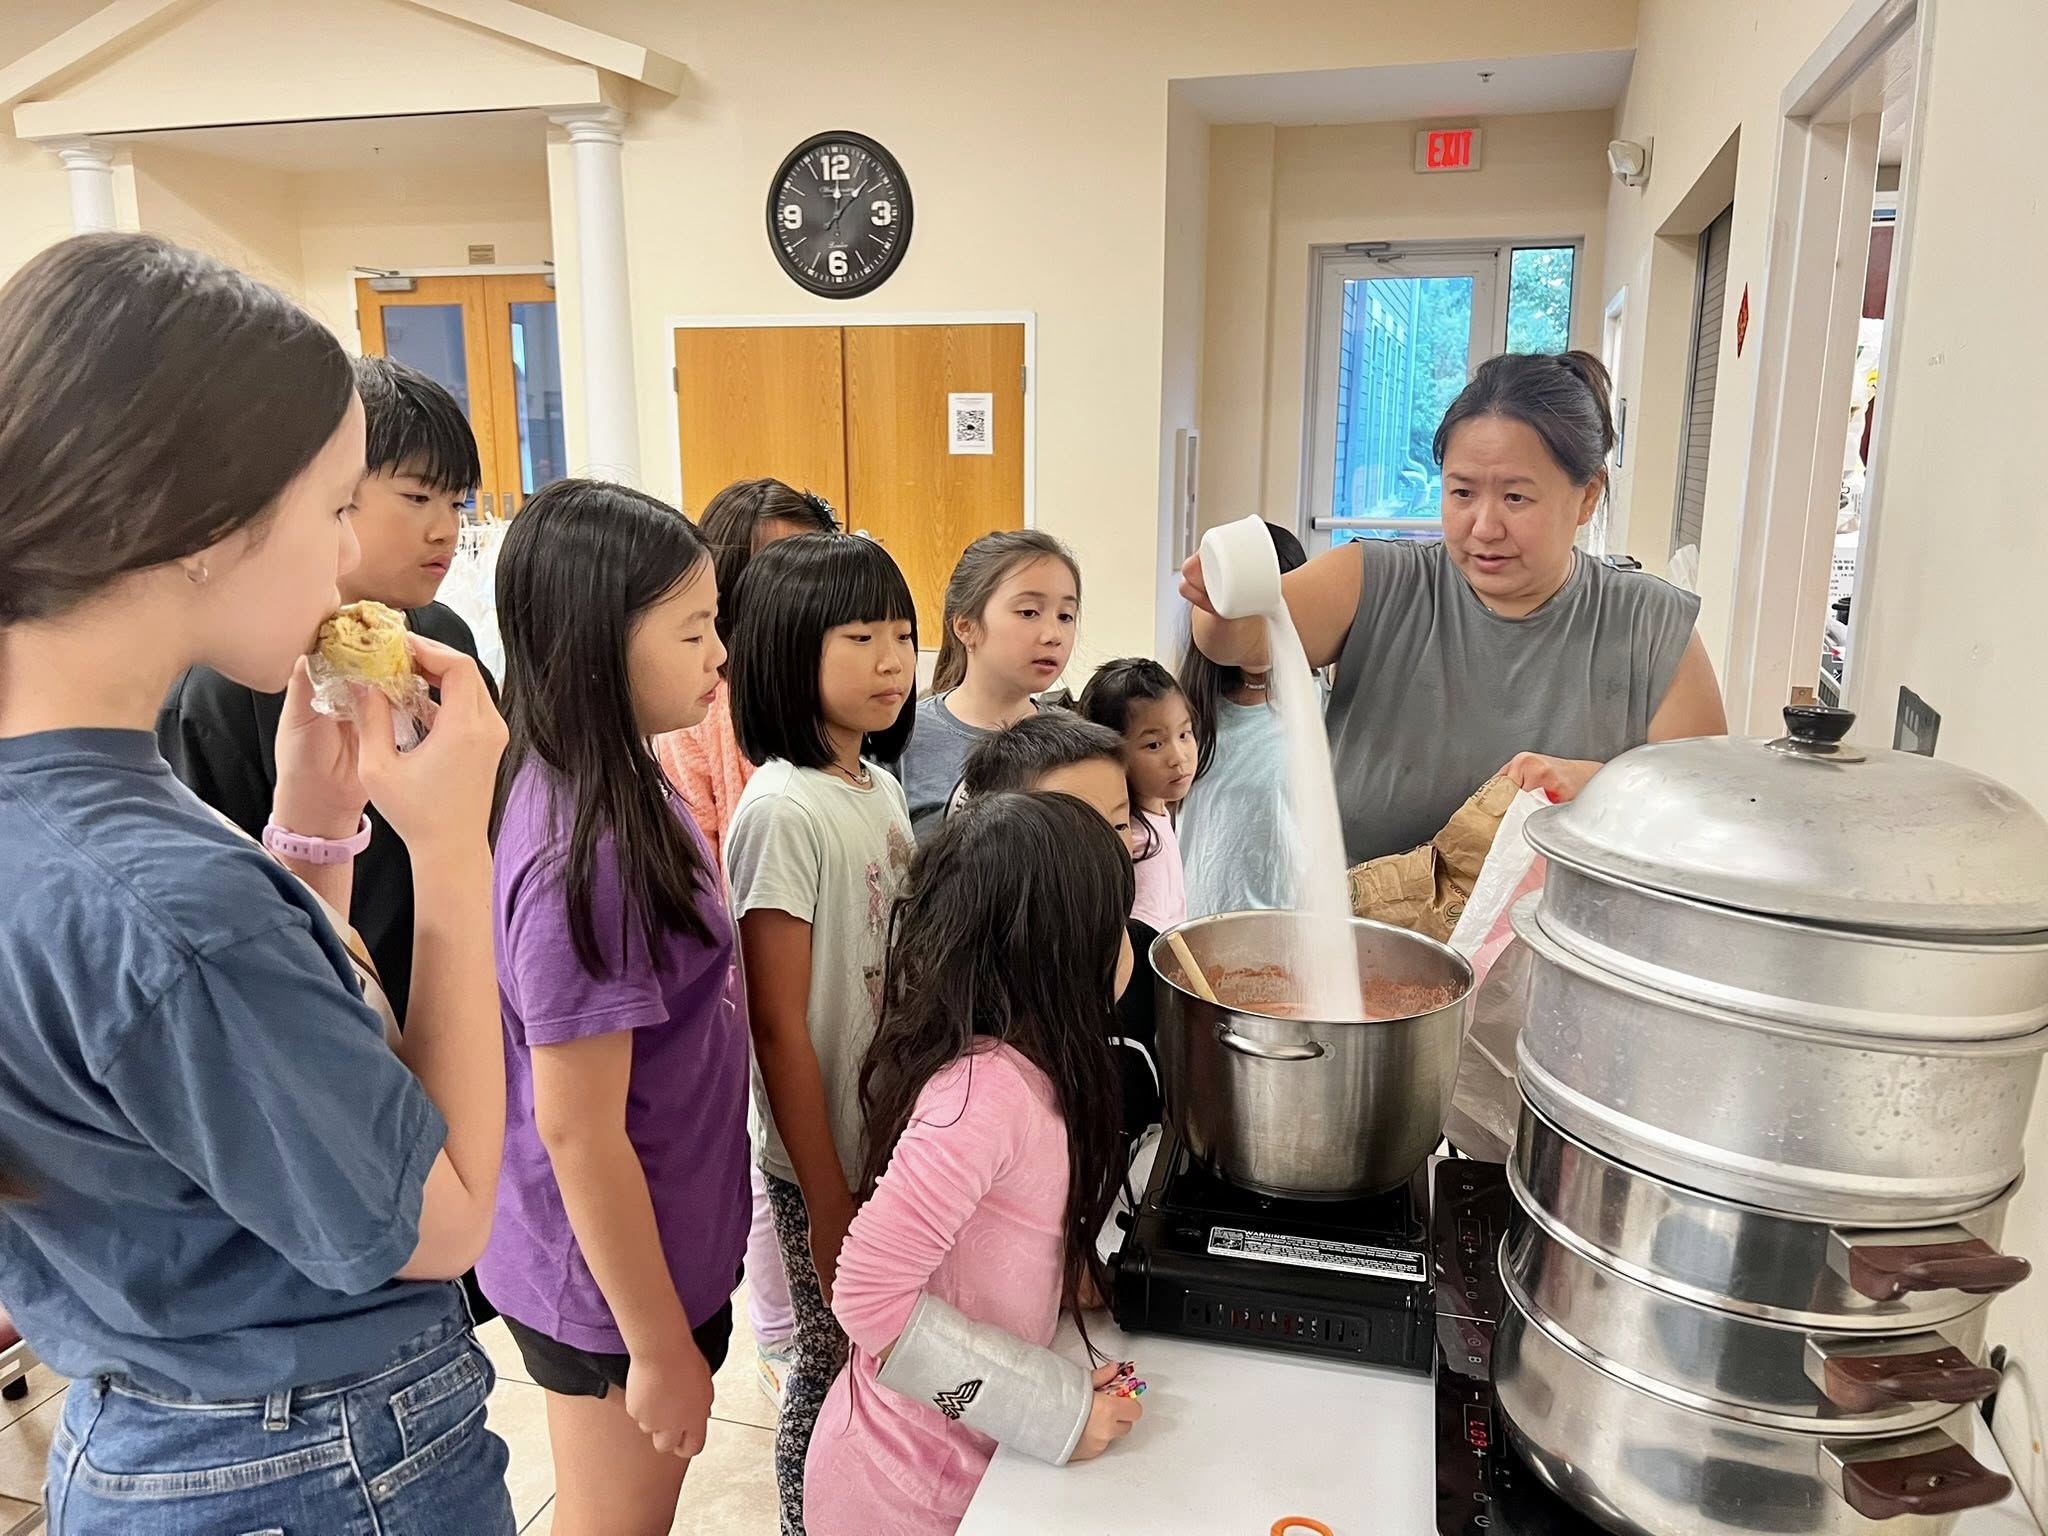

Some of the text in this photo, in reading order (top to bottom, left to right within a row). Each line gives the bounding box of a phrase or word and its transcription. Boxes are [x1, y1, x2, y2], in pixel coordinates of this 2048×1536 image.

[1427, 131, 1473, 167] EXIT
[820, 154, 851, 181] 12
[783, 204, 803, 230] 9
[870, 200, 892, 226] 3
[828, 250, 849, 276] 6
[1245, 1230, 1286, 1240] WARNING
